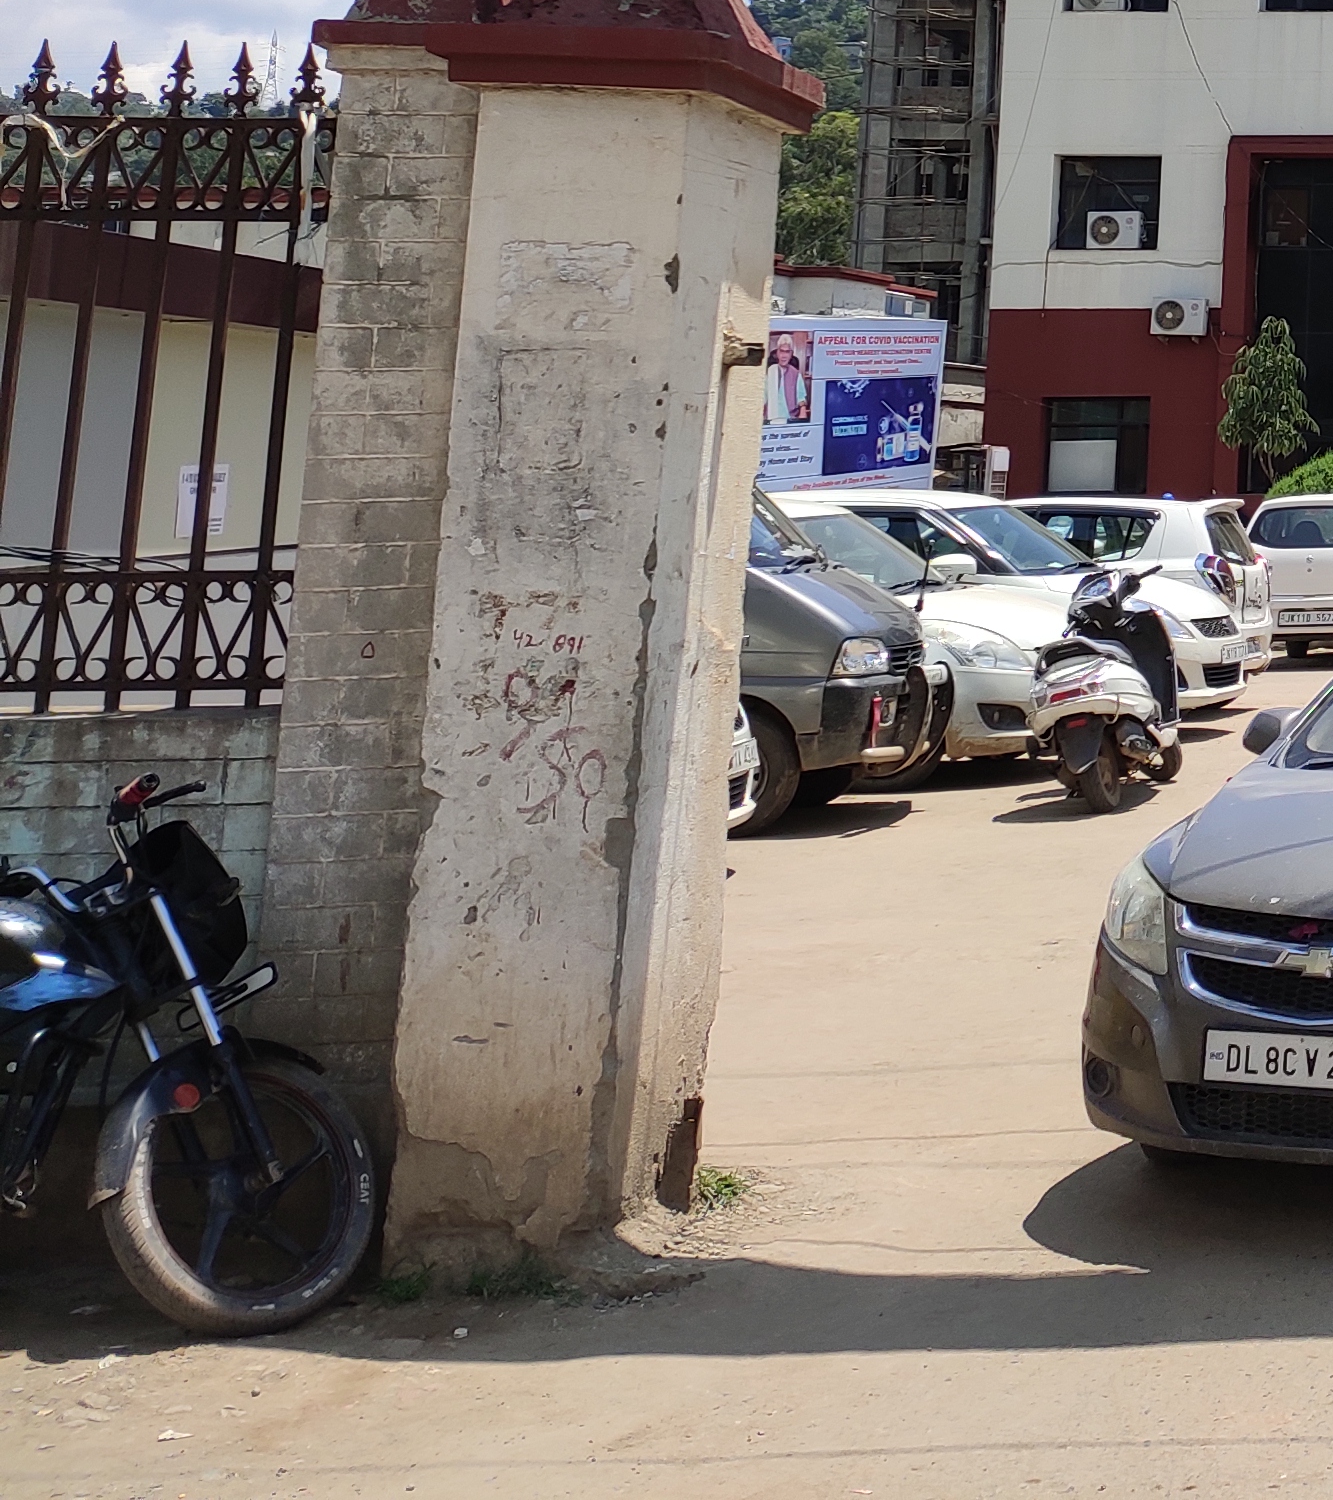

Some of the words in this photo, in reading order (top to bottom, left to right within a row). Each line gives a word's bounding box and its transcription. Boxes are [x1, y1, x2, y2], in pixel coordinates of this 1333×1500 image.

[851, 336, 866, 345] FOR
[869, 336, 891, 345] COVID
[893, 335, 939, 344] VACCINATION
[360, 1173, 370, 1204] CEAT
